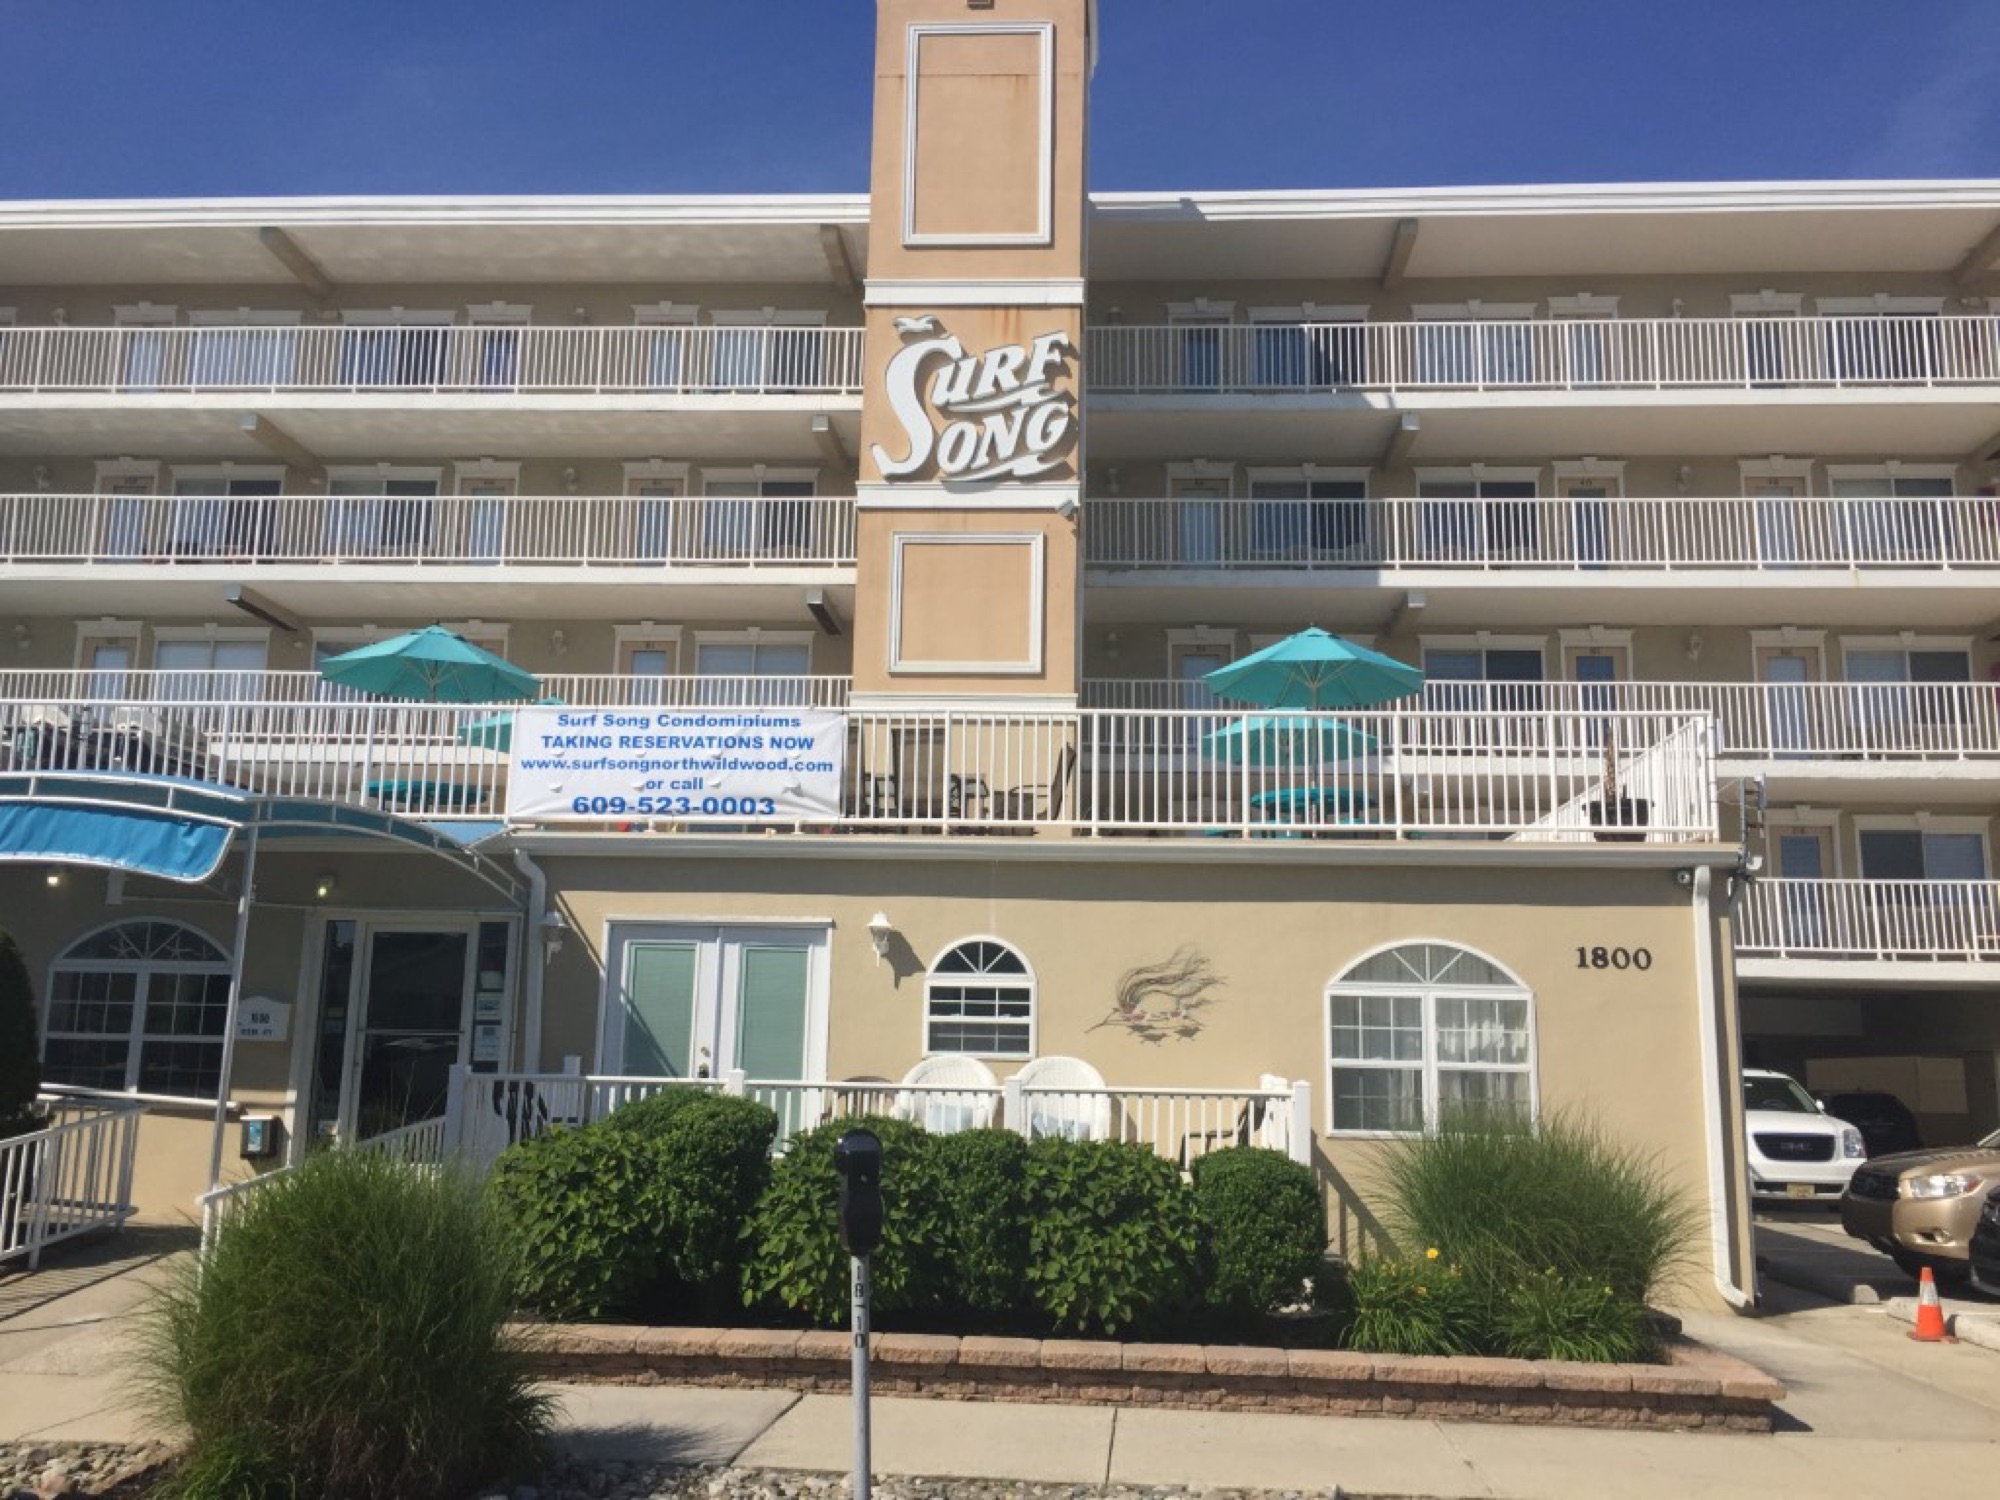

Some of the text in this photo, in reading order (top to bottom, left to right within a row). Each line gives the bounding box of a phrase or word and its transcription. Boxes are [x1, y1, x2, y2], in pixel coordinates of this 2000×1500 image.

[558, 713, 802, 731] Surf Song Condominiums
[542, 735, 815, 751] TAKING RESERVATIONS NOW
[520, 756, 834, 773] www.surfsongnorthwildwood.com
[645, 777, 704, 791] or call
[571, 796, 777, 816] 609-523-0003
[1576, 946, 1653, 971] 1800
